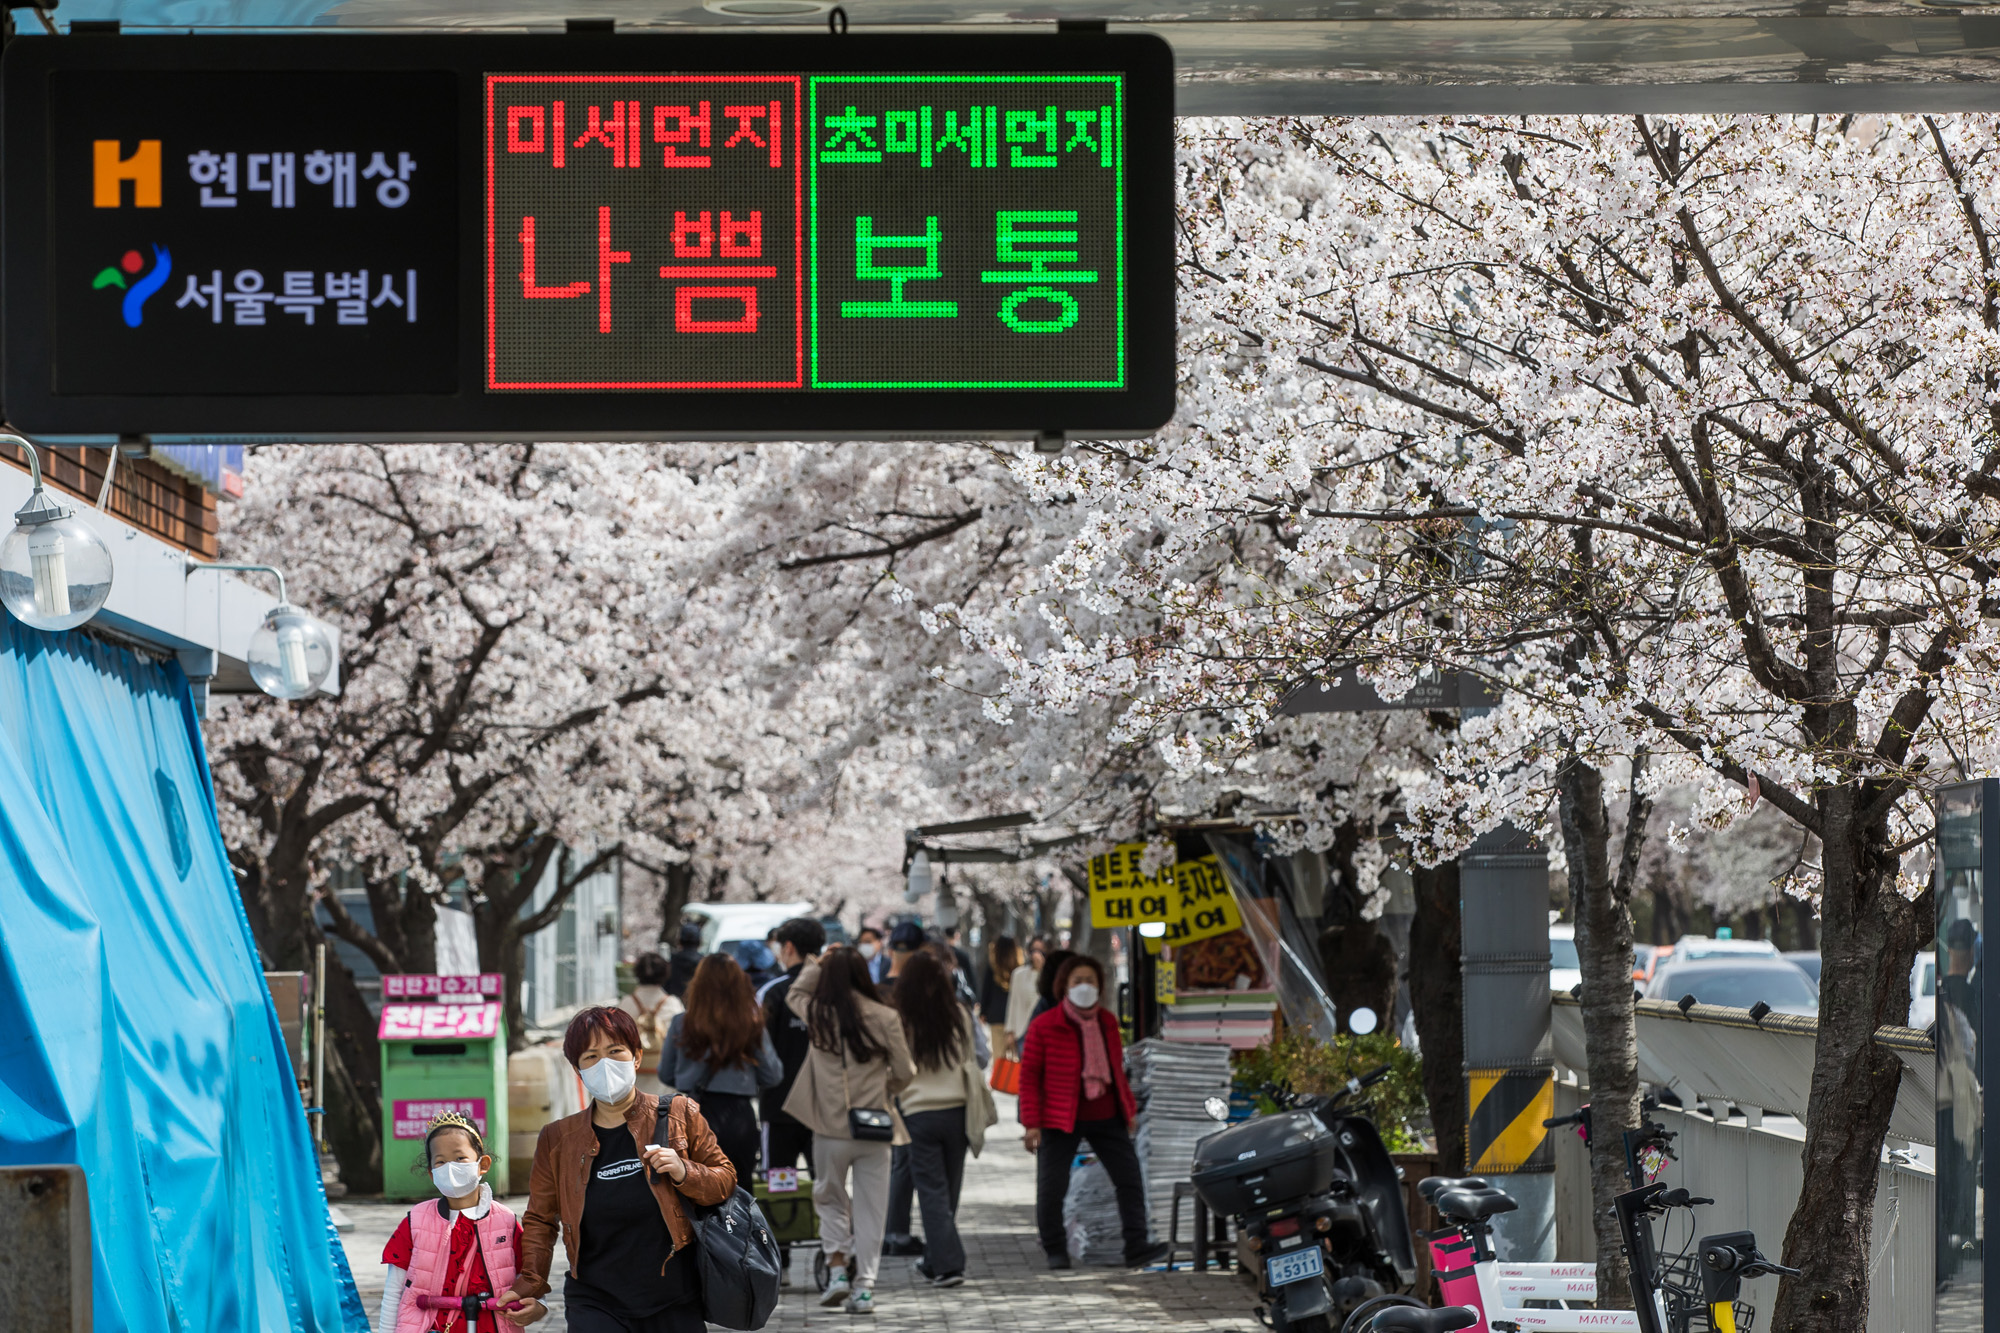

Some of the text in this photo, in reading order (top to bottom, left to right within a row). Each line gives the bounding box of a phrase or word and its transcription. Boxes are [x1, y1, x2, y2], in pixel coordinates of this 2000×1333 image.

[507, 101, 781, 168] 미세먼지
[820, 106, 1113, 167] 초미세먼지
[188, 151, 417, 208] 현대해상
[519, 206, 777, 333] 나쁨
[841, 210, 1098, 333] 보통
[176, 269, 418, 325] 서울특별시
[1106, 895, 1167, 919] 대여
[1164, 907, 1226, 940] 대여
[385, 1003, 497, 1036] 전단지
[1284, 1259, 1316, 1278] 5311
[1550, 1268, 1585, 1276] MARY
[1567, 1283, 1597, 1292] MAR
[1579, 1315, 1618, 1325] MARY
